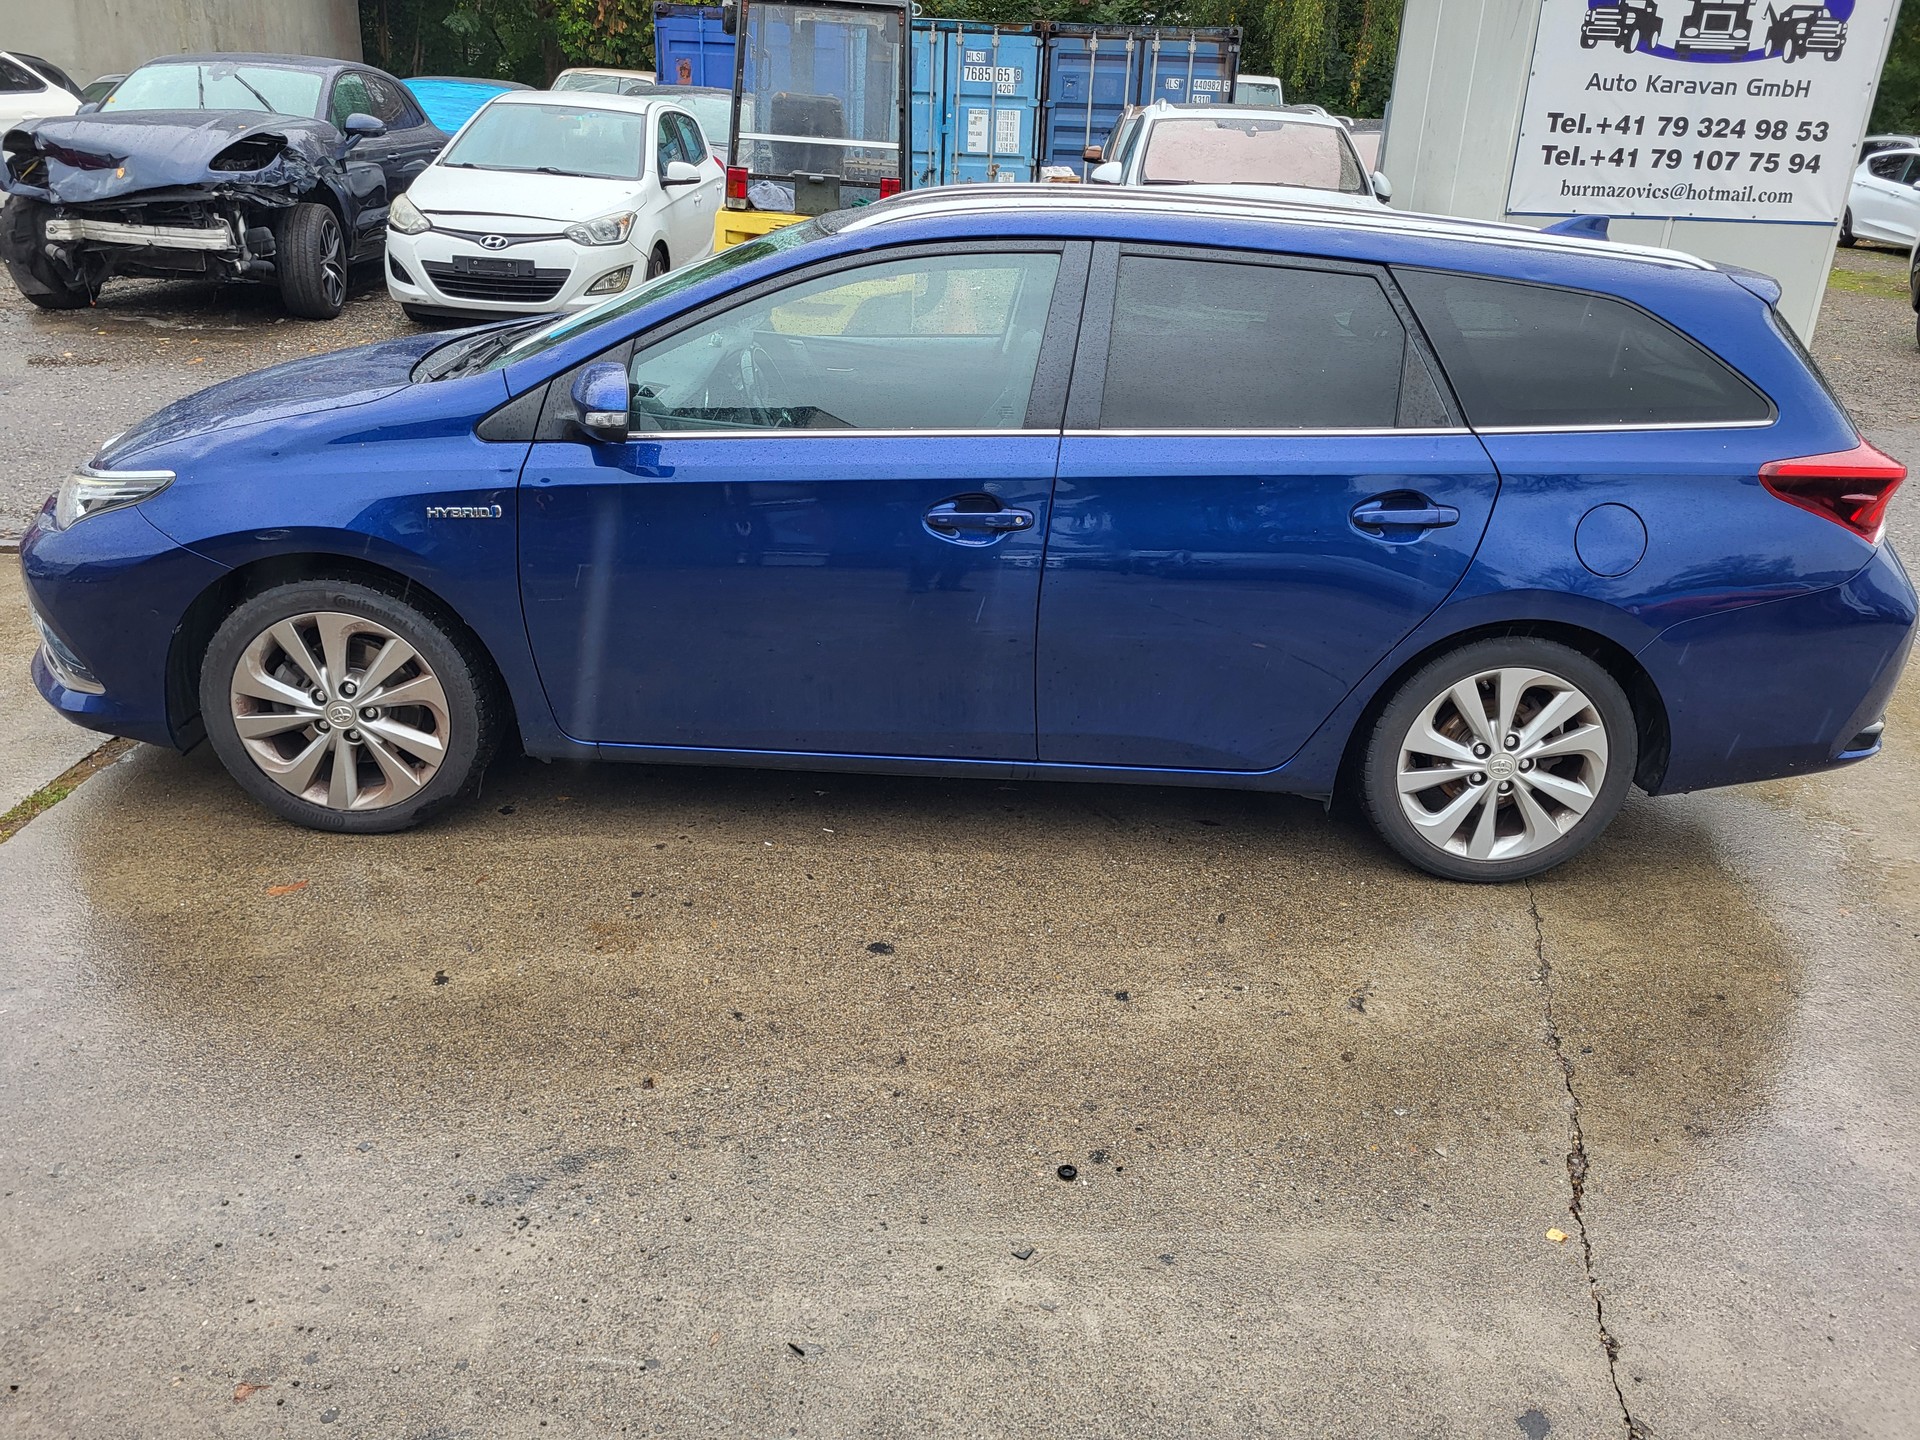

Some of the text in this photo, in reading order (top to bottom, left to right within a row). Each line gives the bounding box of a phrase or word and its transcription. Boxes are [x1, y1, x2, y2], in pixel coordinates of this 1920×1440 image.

[966, 51, 986, 62] HLSU
[1584, 72, 1811, 98] Auto Karavan GmbH
[1546, 112, 1830, 142] Tel.+41 79 324 98 53
[1540, 144, 1822, 174] Tel.+41 79 107 75 94
[1559, 179, 1793, 204] burmazovics@hotmail.com
[426, 506, 490, 518] HYBRID
